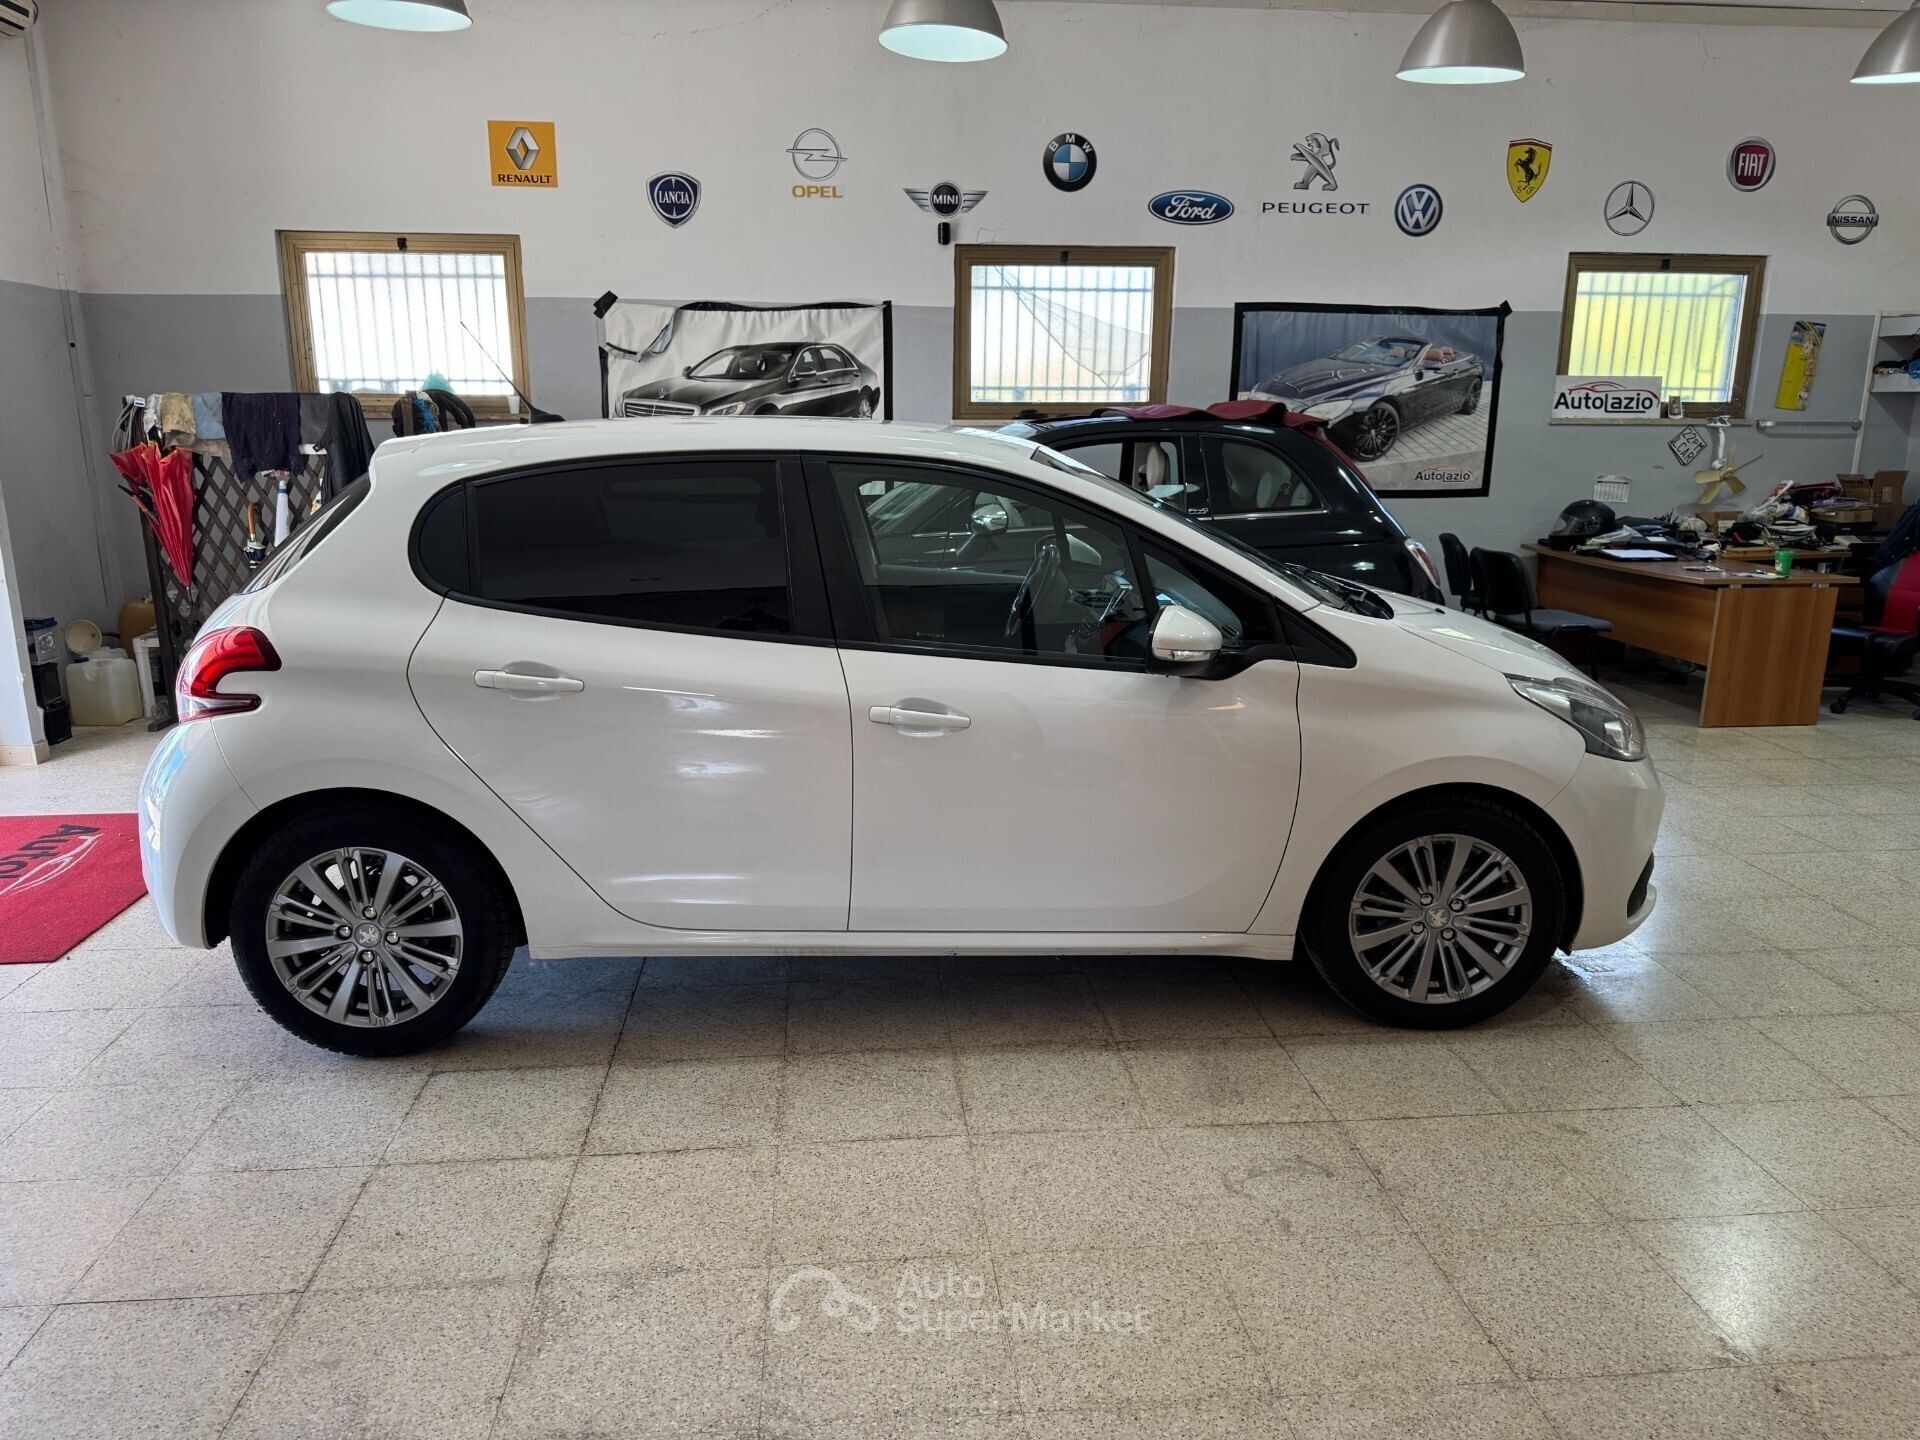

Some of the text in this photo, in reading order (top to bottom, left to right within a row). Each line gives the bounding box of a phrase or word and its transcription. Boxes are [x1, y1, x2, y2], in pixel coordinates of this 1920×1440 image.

[1049, 134, 1093, 152] BMW
[1737, 153, 1766, 177] FIAT
[497, 173, 553, 184] RENAULT
[658, 190, 690, 204] LANCIA
[791, 185, 844, 198] OPEL
[933, 194, 959, 205] MINI
[1164, 195, 1218, 219] Ford
[1262, 202, 1370, 214] PEUGEOT
[1832, 215, 1874, 224] NISSAN
